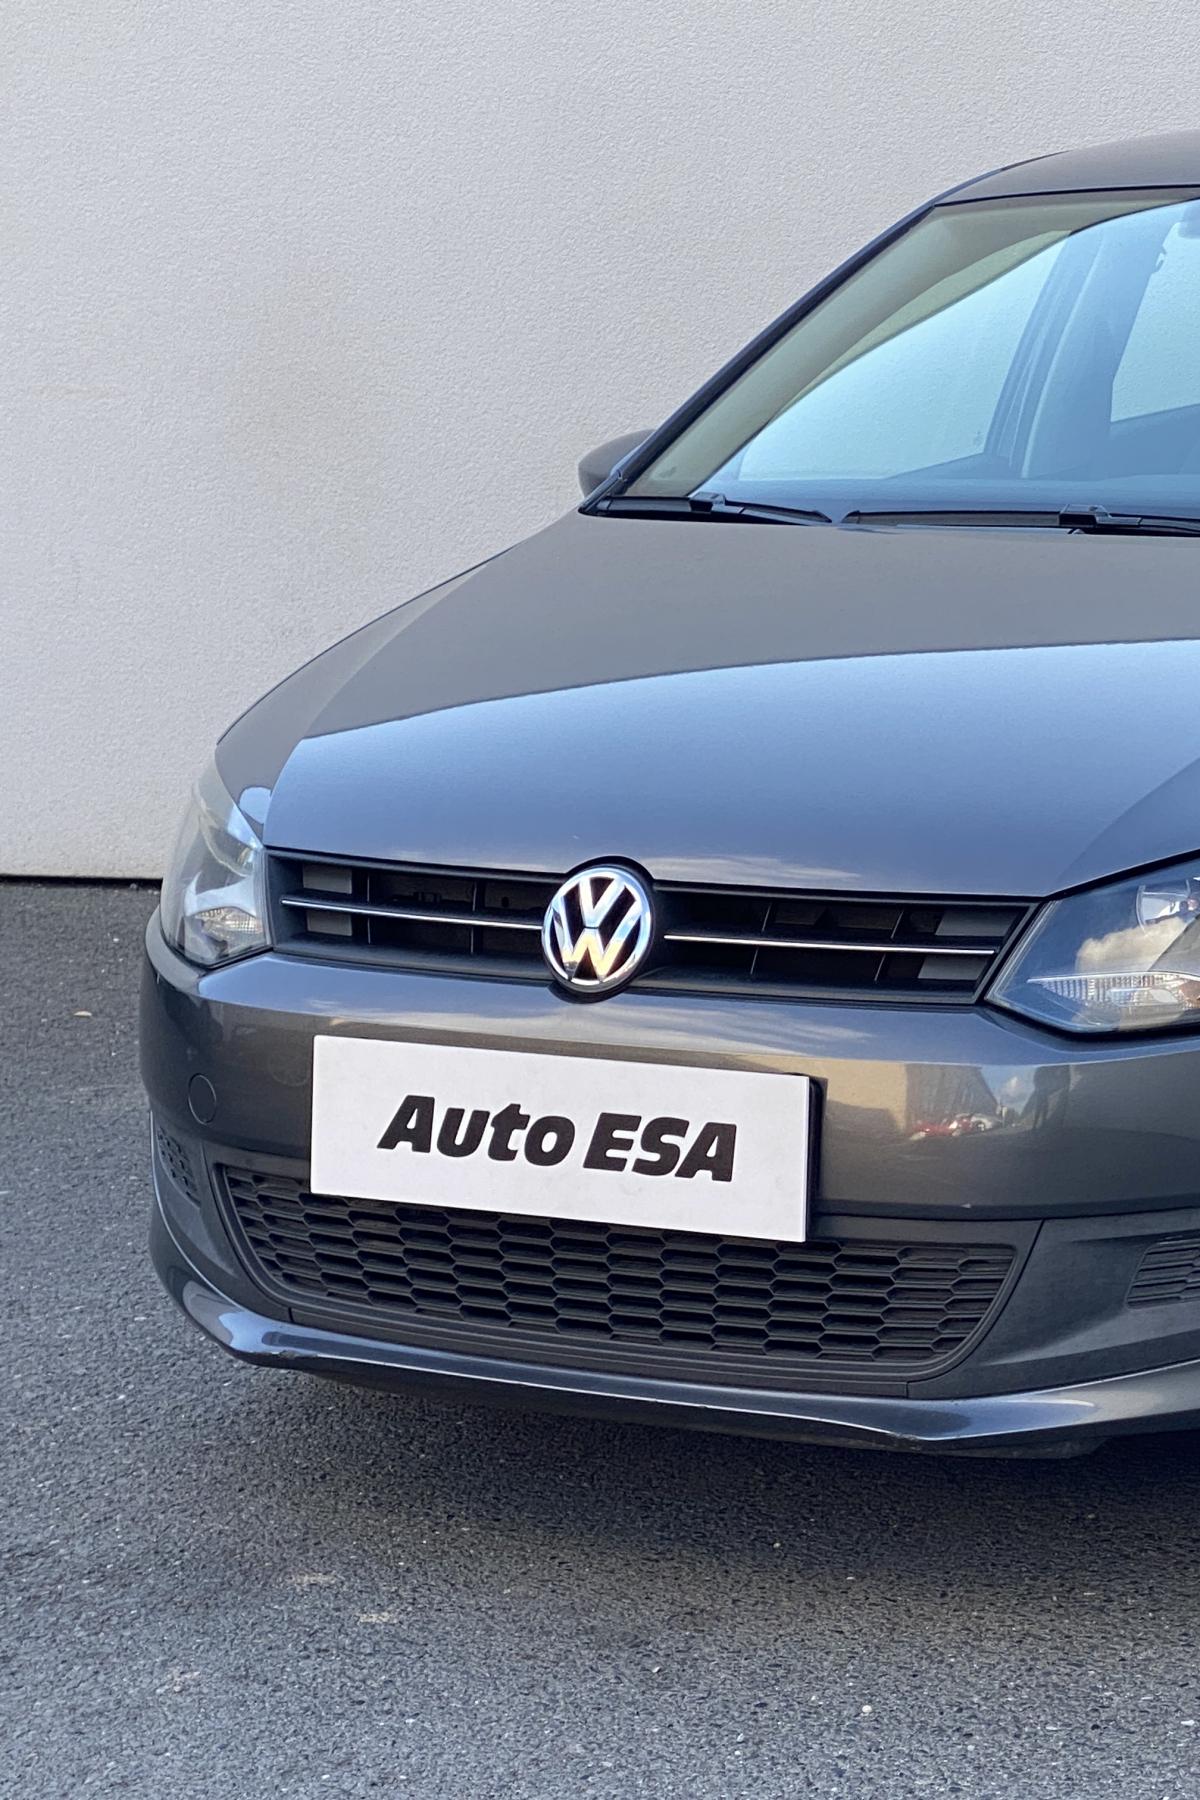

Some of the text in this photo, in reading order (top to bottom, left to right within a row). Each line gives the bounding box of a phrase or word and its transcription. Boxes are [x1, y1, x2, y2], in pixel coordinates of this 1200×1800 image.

[545, 870, 648, 986] VW
[376, 1094, 737, 1183] Auto ESA
